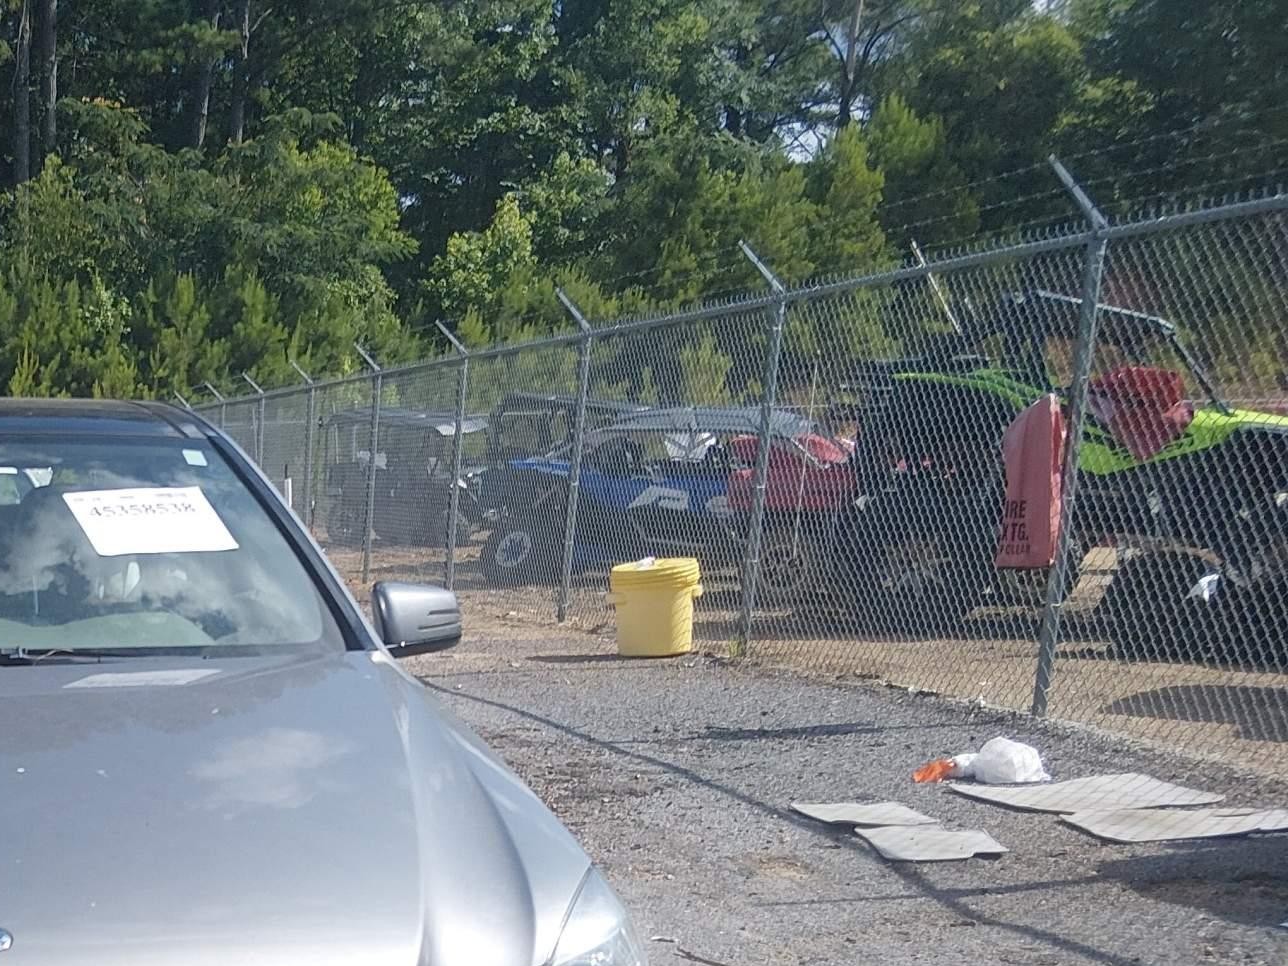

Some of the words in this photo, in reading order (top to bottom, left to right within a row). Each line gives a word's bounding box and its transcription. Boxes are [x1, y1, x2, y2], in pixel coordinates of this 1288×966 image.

[90, 503, 196, 517] 45358538
[1004, 500, 1026, 518] IRE
[1001, 523, 1029, 541] XTG.
